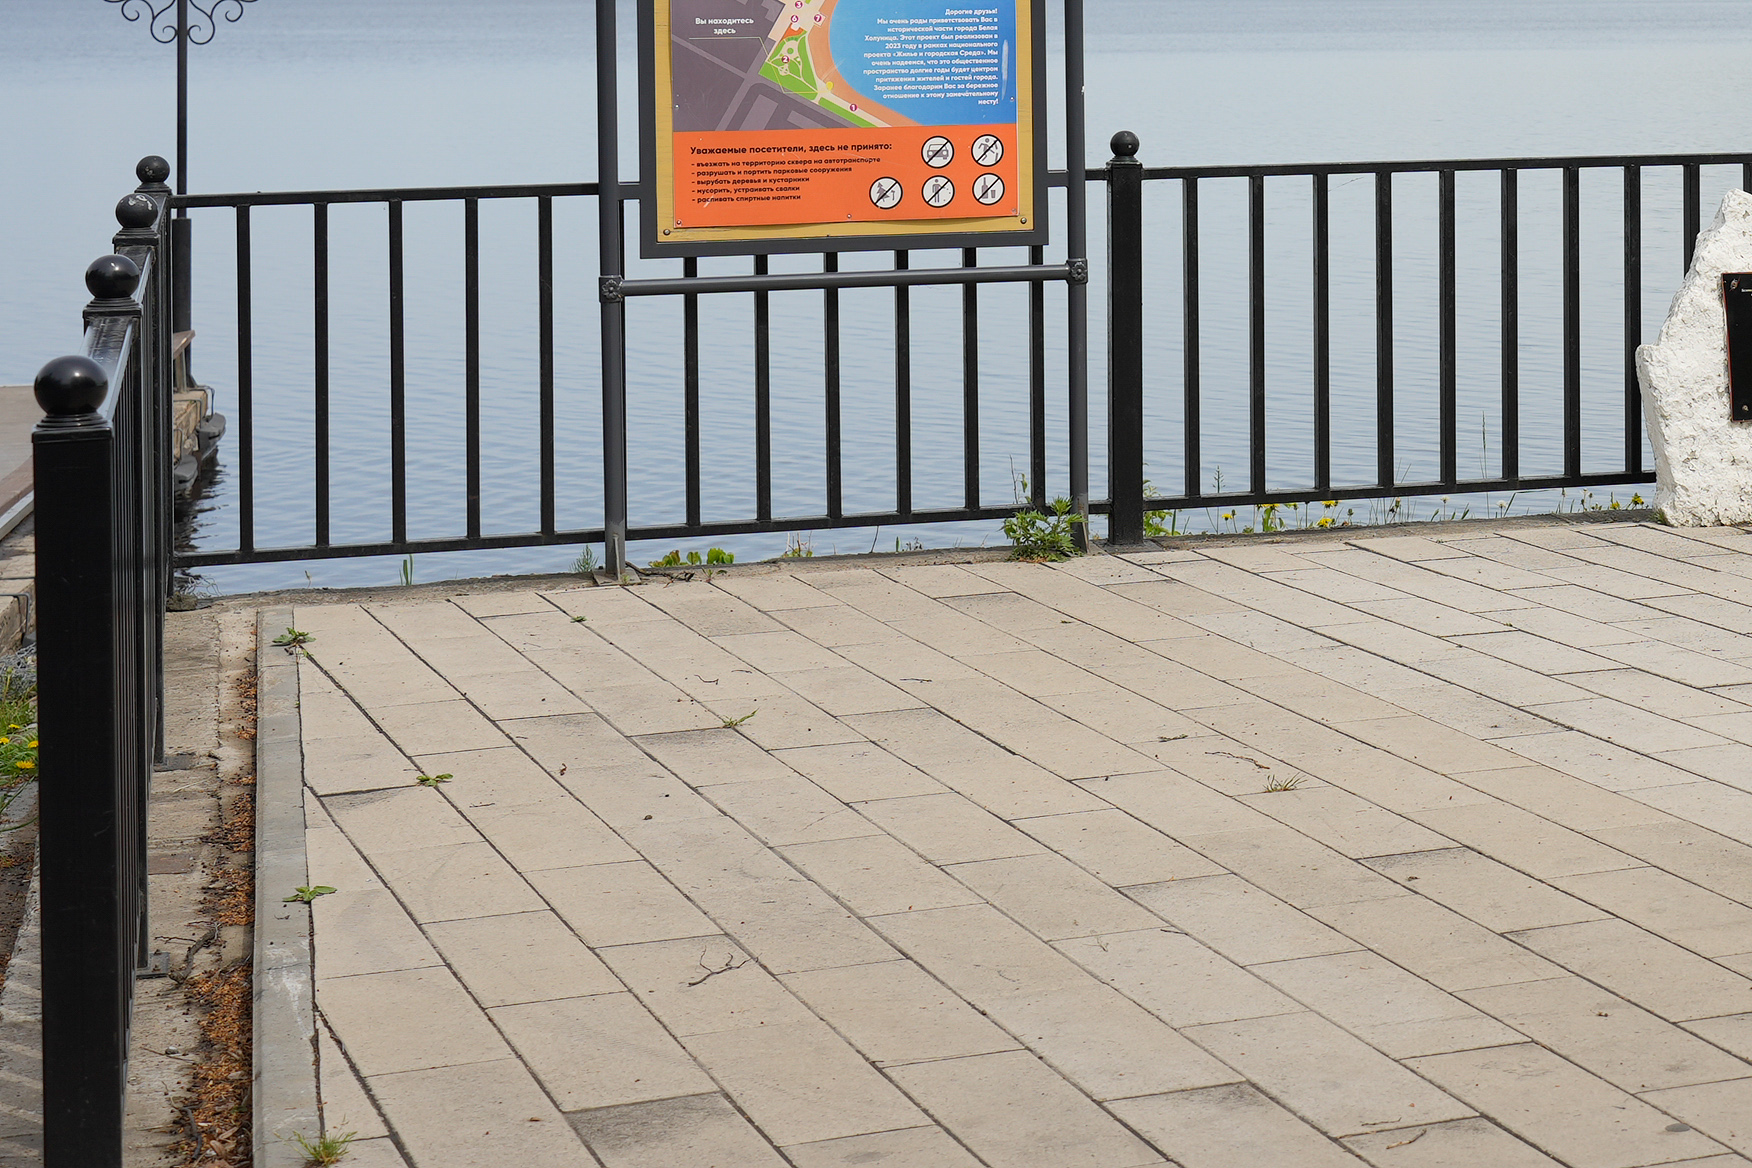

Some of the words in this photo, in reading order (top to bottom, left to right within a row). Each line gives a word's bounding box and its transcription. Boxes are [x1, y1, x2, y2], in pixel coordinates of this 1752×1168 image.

[945, 8, 973, 16] Дорогие
[973, 8, 998, 16] друзья!
[695, 17, 707, 25] Вы
[951, 66, 970, 74] будет
[690, 146, 747, 155] Уважаемые
[749, 146, 807, 154] посетители,
[809, 145, 835, 153] здесь
[851, 143, 892, 151] принято:
